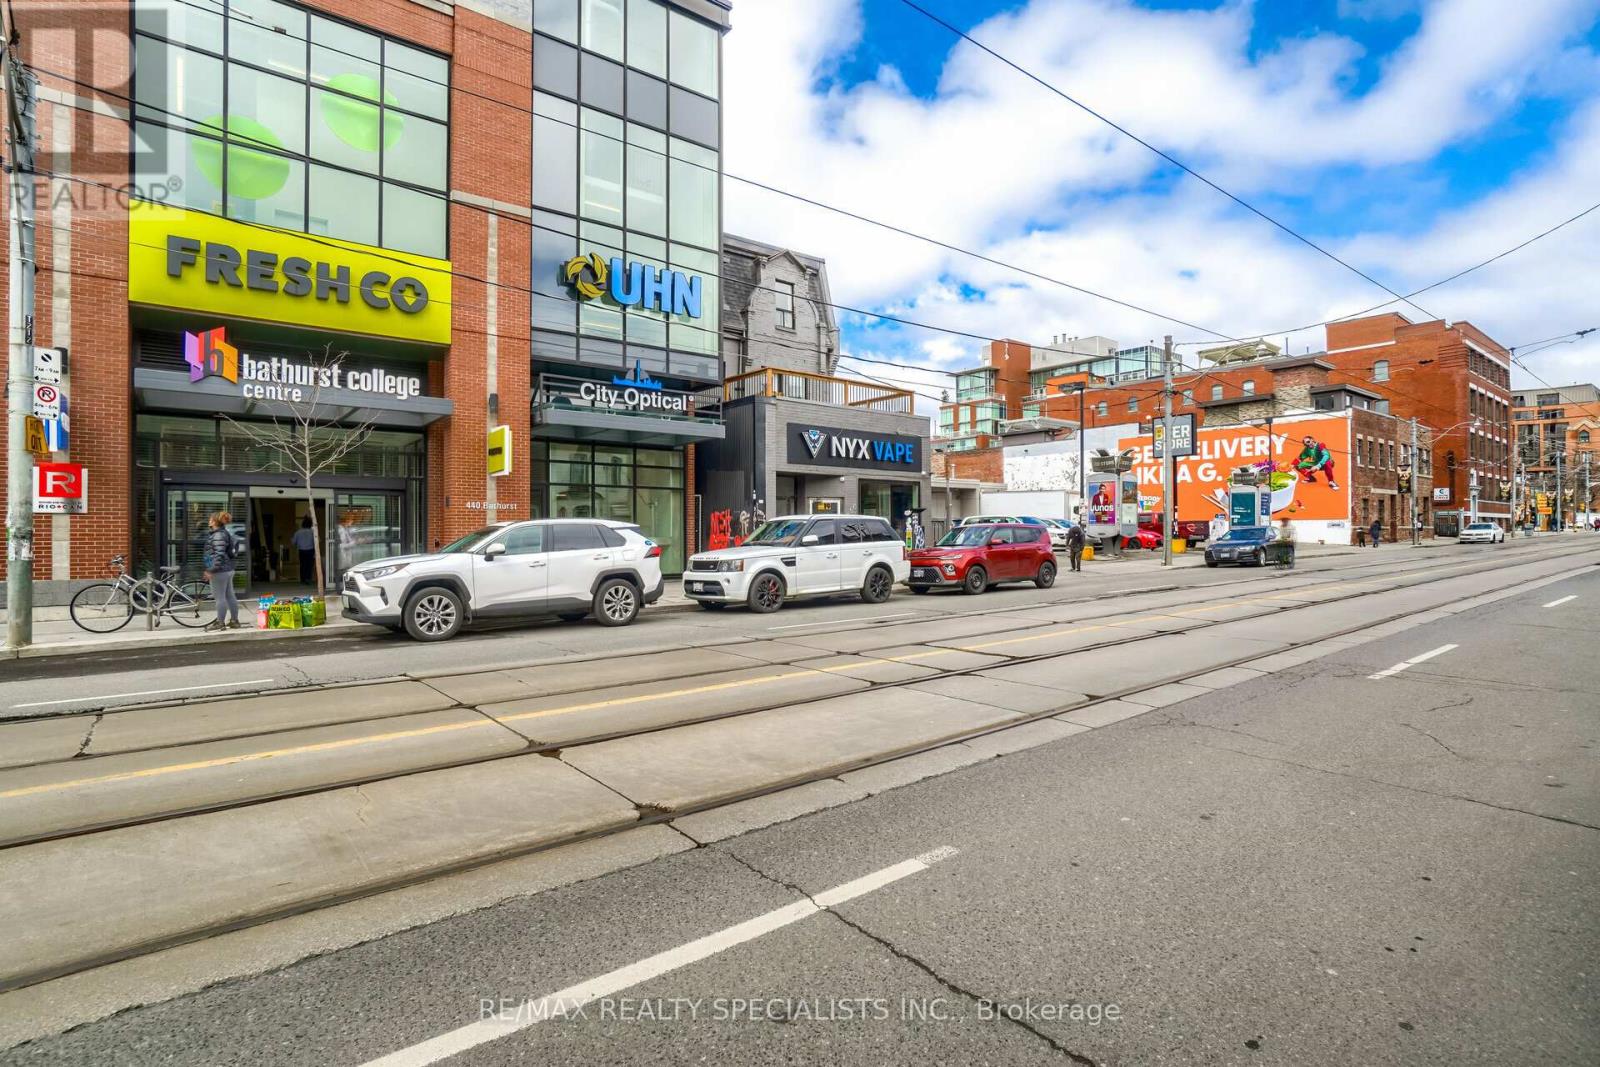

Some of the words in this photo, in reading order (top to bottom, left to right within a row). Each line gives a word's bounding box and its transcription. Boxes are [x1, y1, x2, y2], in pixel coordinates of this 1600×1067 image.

[610, 257, 702, 318] UHN
[243, 354, 341, 389] bathurst
[347, 369, 420, 400] college
[243, 383, 301, 402] centre
[580, 382, 618, 407] City
[1155, 425, 1190, 440] BER
[831, 436, 870, 460] NYX
[873, 440, 914, 463] VAPE
[46, 471, 75, 494] R
[1197, 463, 1223, 482] G.
[466, 501, 481, 509] 440
[483, 501, 517, 510] Bathurst
